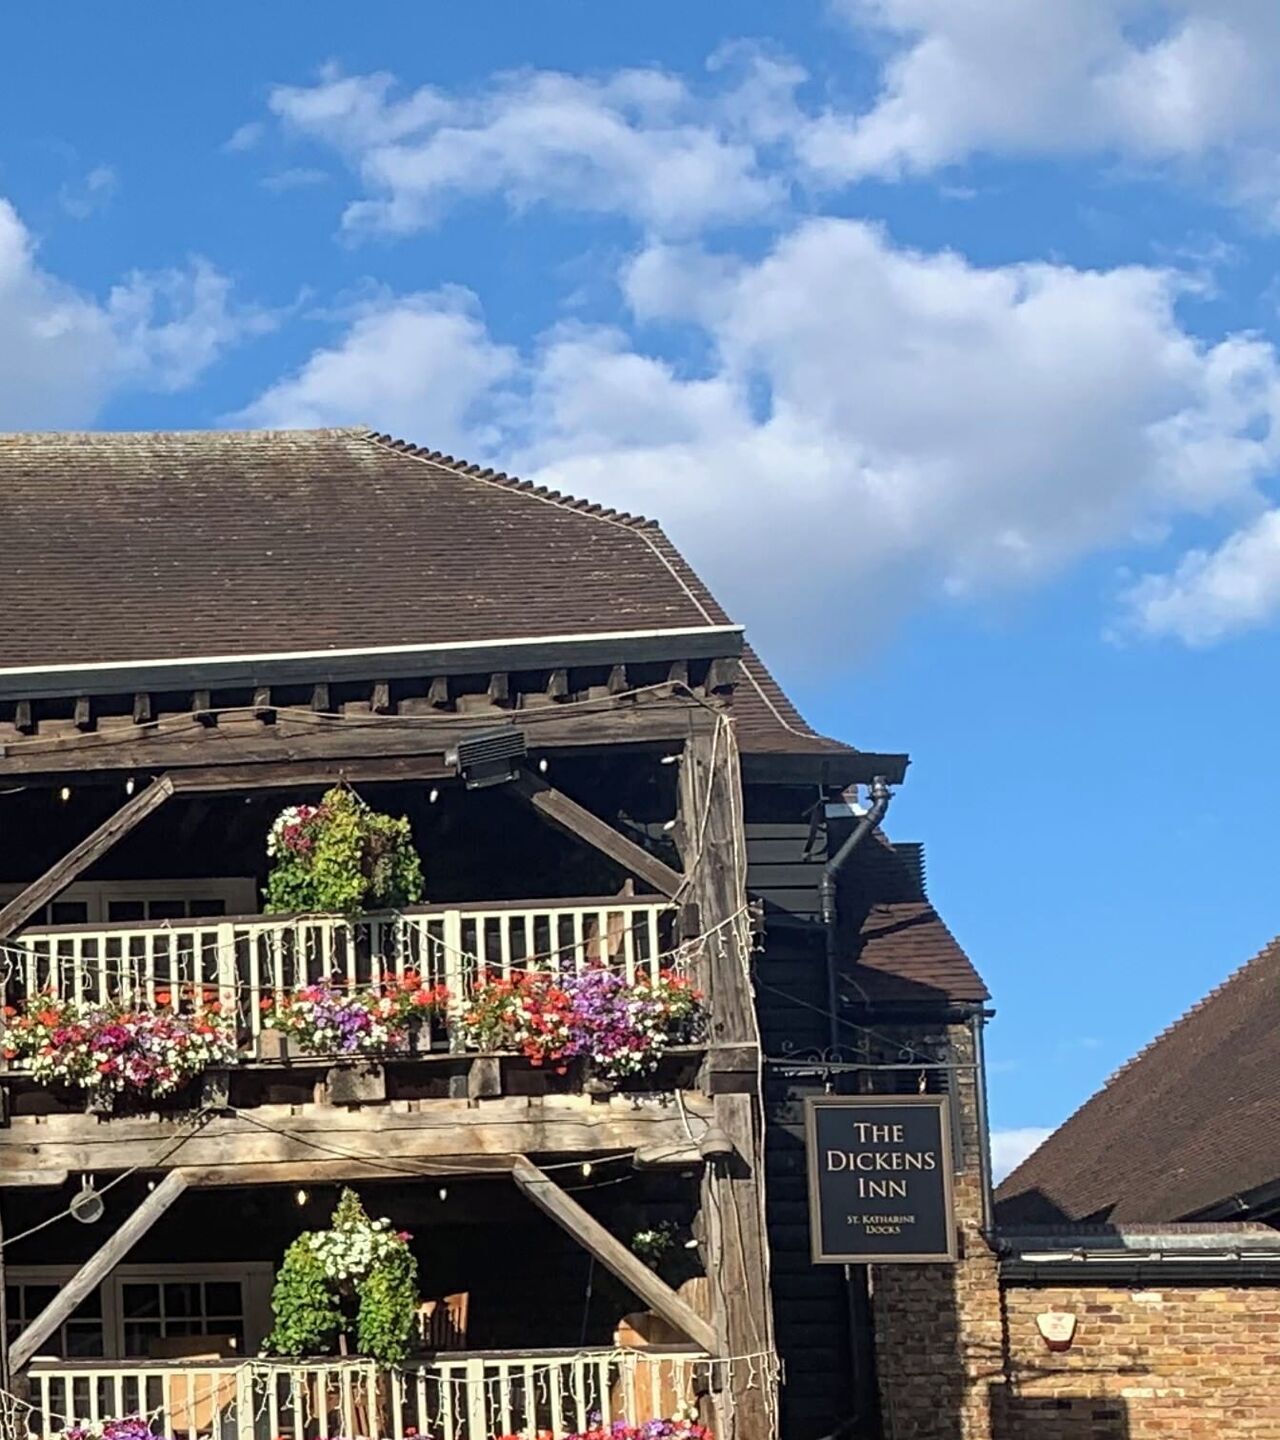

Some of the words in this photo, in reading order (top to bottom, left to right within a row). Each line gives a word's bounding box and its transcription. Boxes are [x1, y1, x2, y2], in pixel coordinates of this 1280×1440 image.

[853, 1122, 904, 1143] THE
[827, 1150, 936, 1171] DICKENS
[858, 1178, 907, 1198] INN
